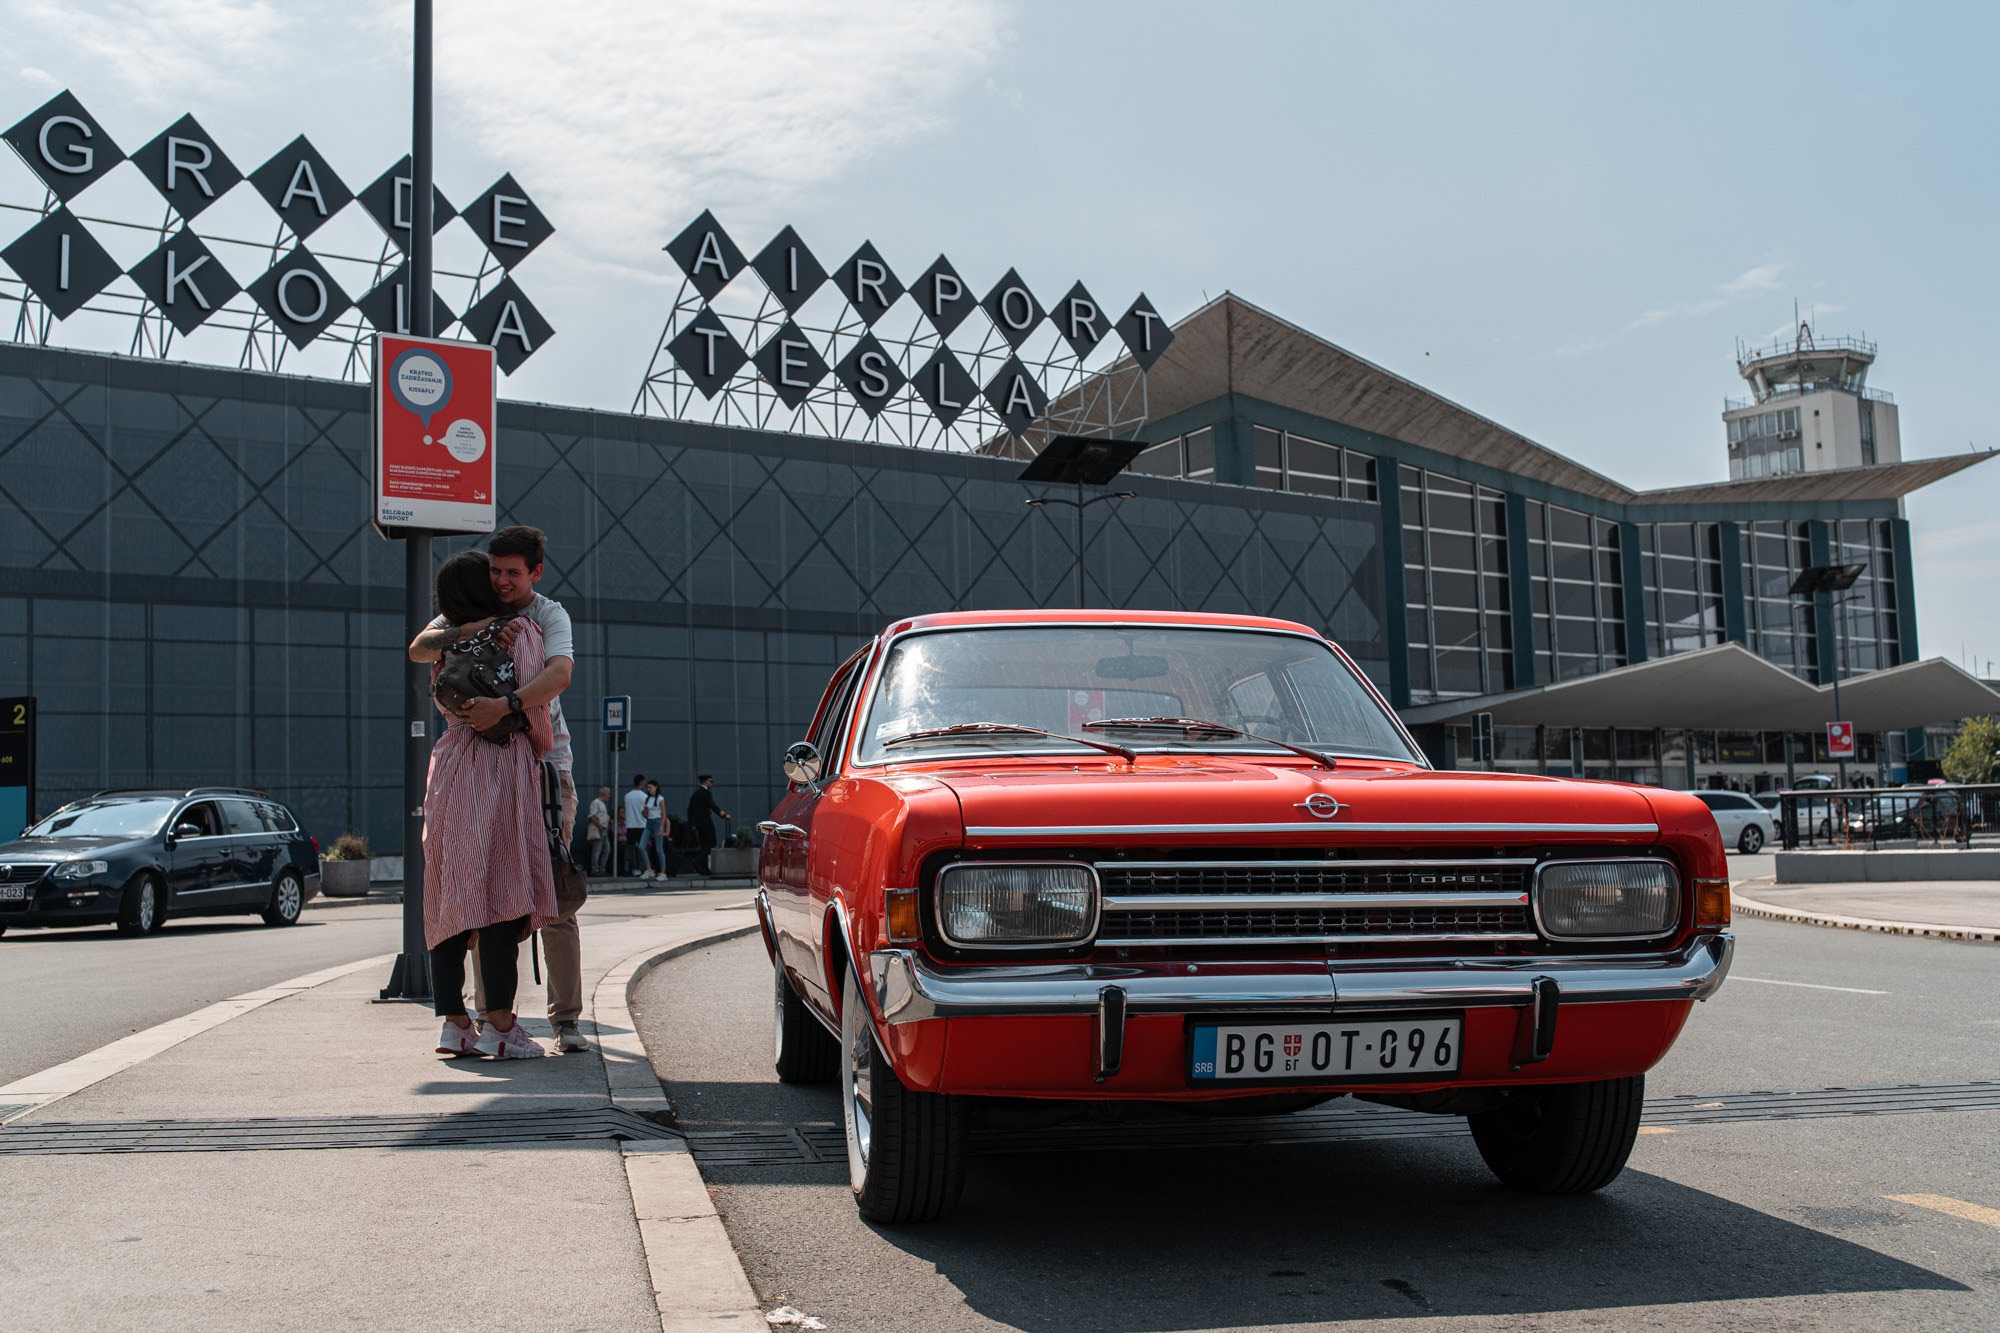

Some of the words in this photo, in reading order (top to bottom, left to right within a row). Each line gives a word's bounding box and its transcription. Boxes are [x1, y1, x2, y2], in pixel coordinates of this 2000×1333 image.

[692, 231, 1159, 352] AIRPORT
[409, 369, 433, 377] KRATKO
[695, 326, 1036, 418] TESLA
[382, 509, 413, 517] BELGRADE
[13, 704, 26, 725] 2
[609, 709, 621, 719] TAXI
[1225, 1033, 1275, 1074] BG
[1195, 1062, 1214, 1073] SRB
